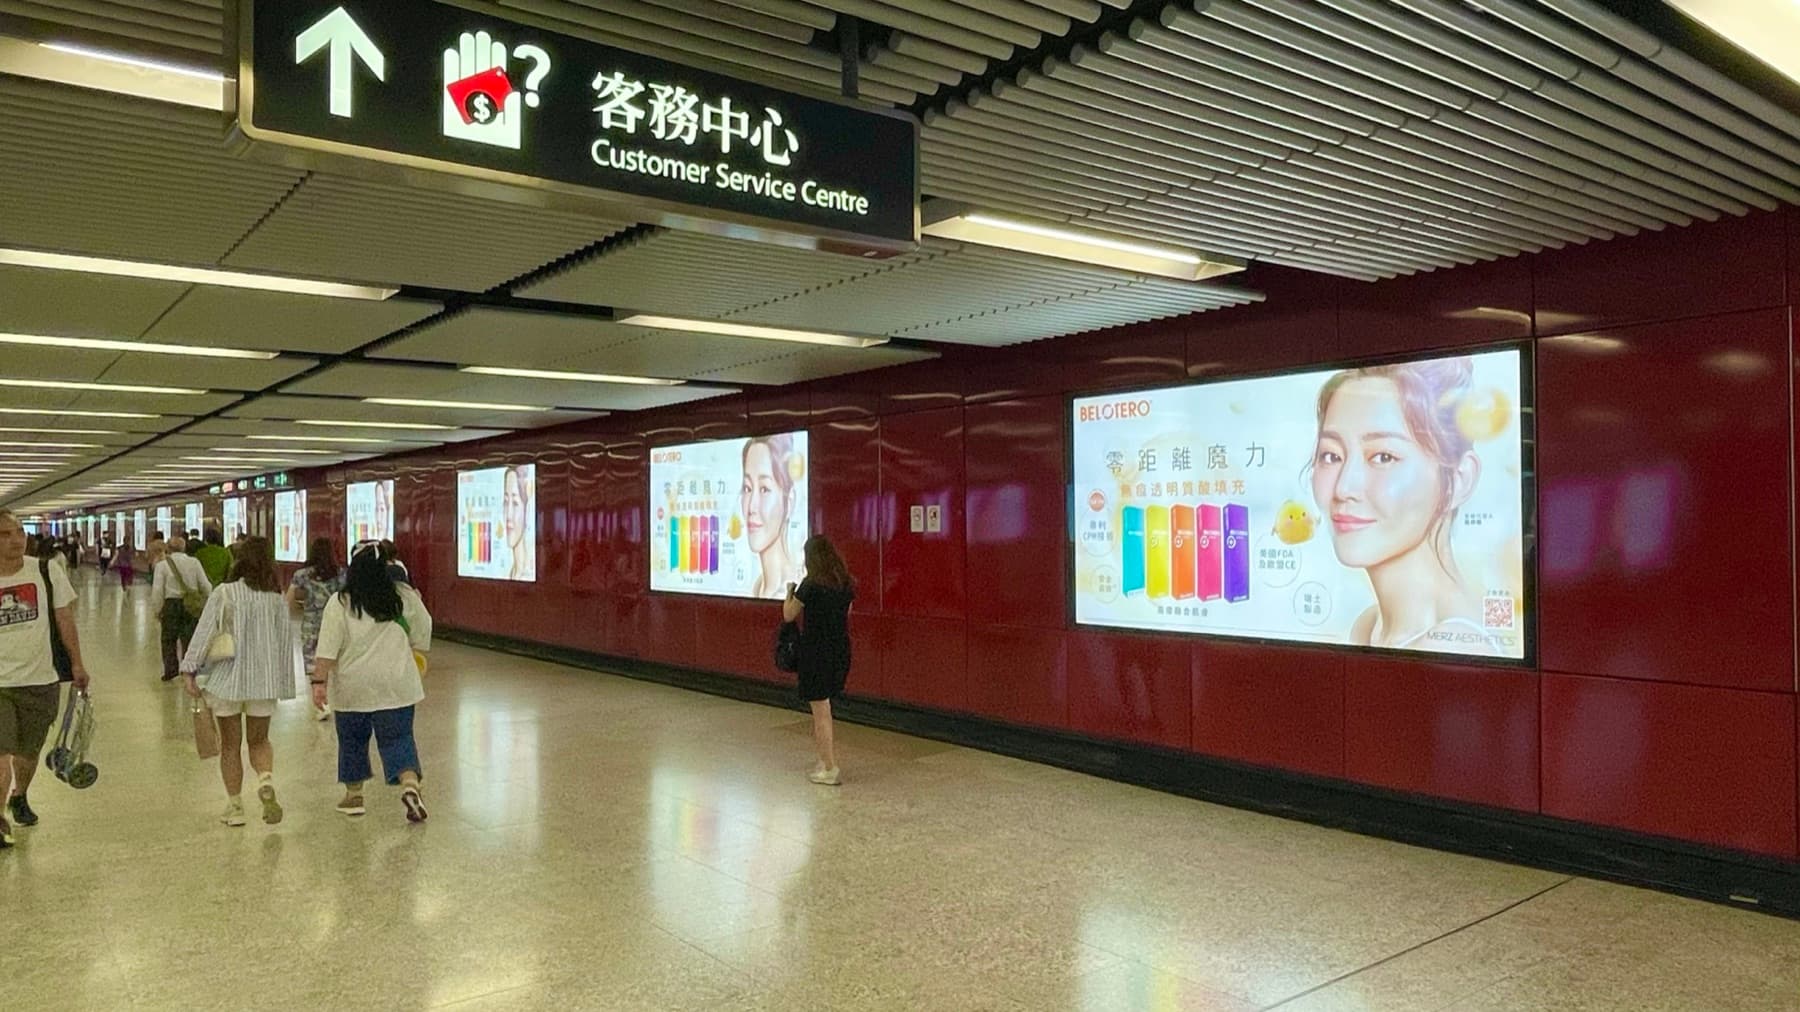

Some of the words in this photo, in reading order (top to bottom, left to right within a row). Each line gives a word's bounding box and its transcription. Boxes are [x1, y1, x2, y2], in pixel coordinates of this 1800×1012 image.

[591, 71, 799, 167] 客務中心
[591, 139, 710, 185] Customer
[716, 163, 796, 201] Service
[801, 180, 869, 216] Centre
[1080, 400, 1150, 422] BELOTERO
[1106, 441, 1265, 474] 零距離魔力
